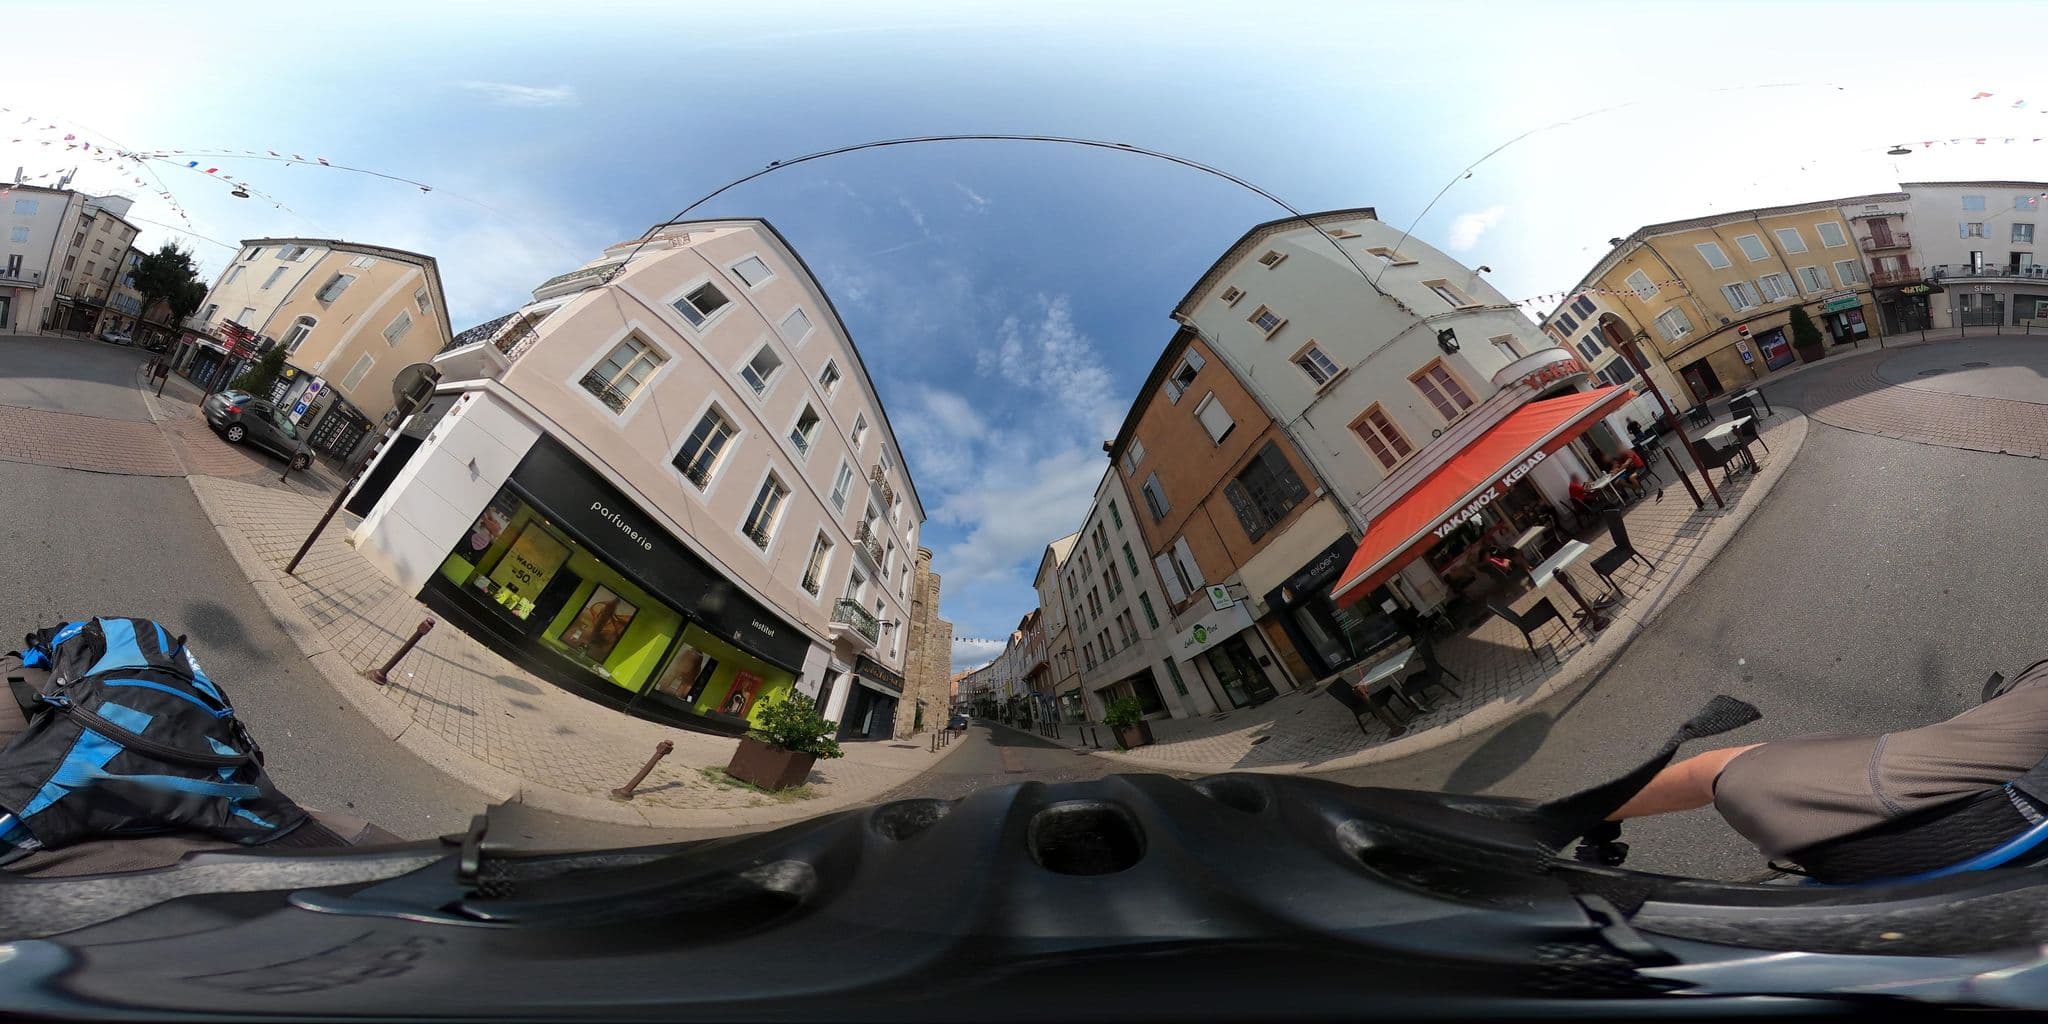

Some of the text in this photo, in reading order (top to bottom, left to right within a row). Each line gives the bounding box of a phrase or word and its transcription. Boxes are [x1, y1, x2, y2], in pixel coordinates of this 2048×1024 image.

[1433, 450, 1547, 538] YAKAMOZ KEBAB
[590, 501, 652, 551] parfumerie
[1310, 551, 1340, 576] expert
[751, 619, 775, 638] institut
